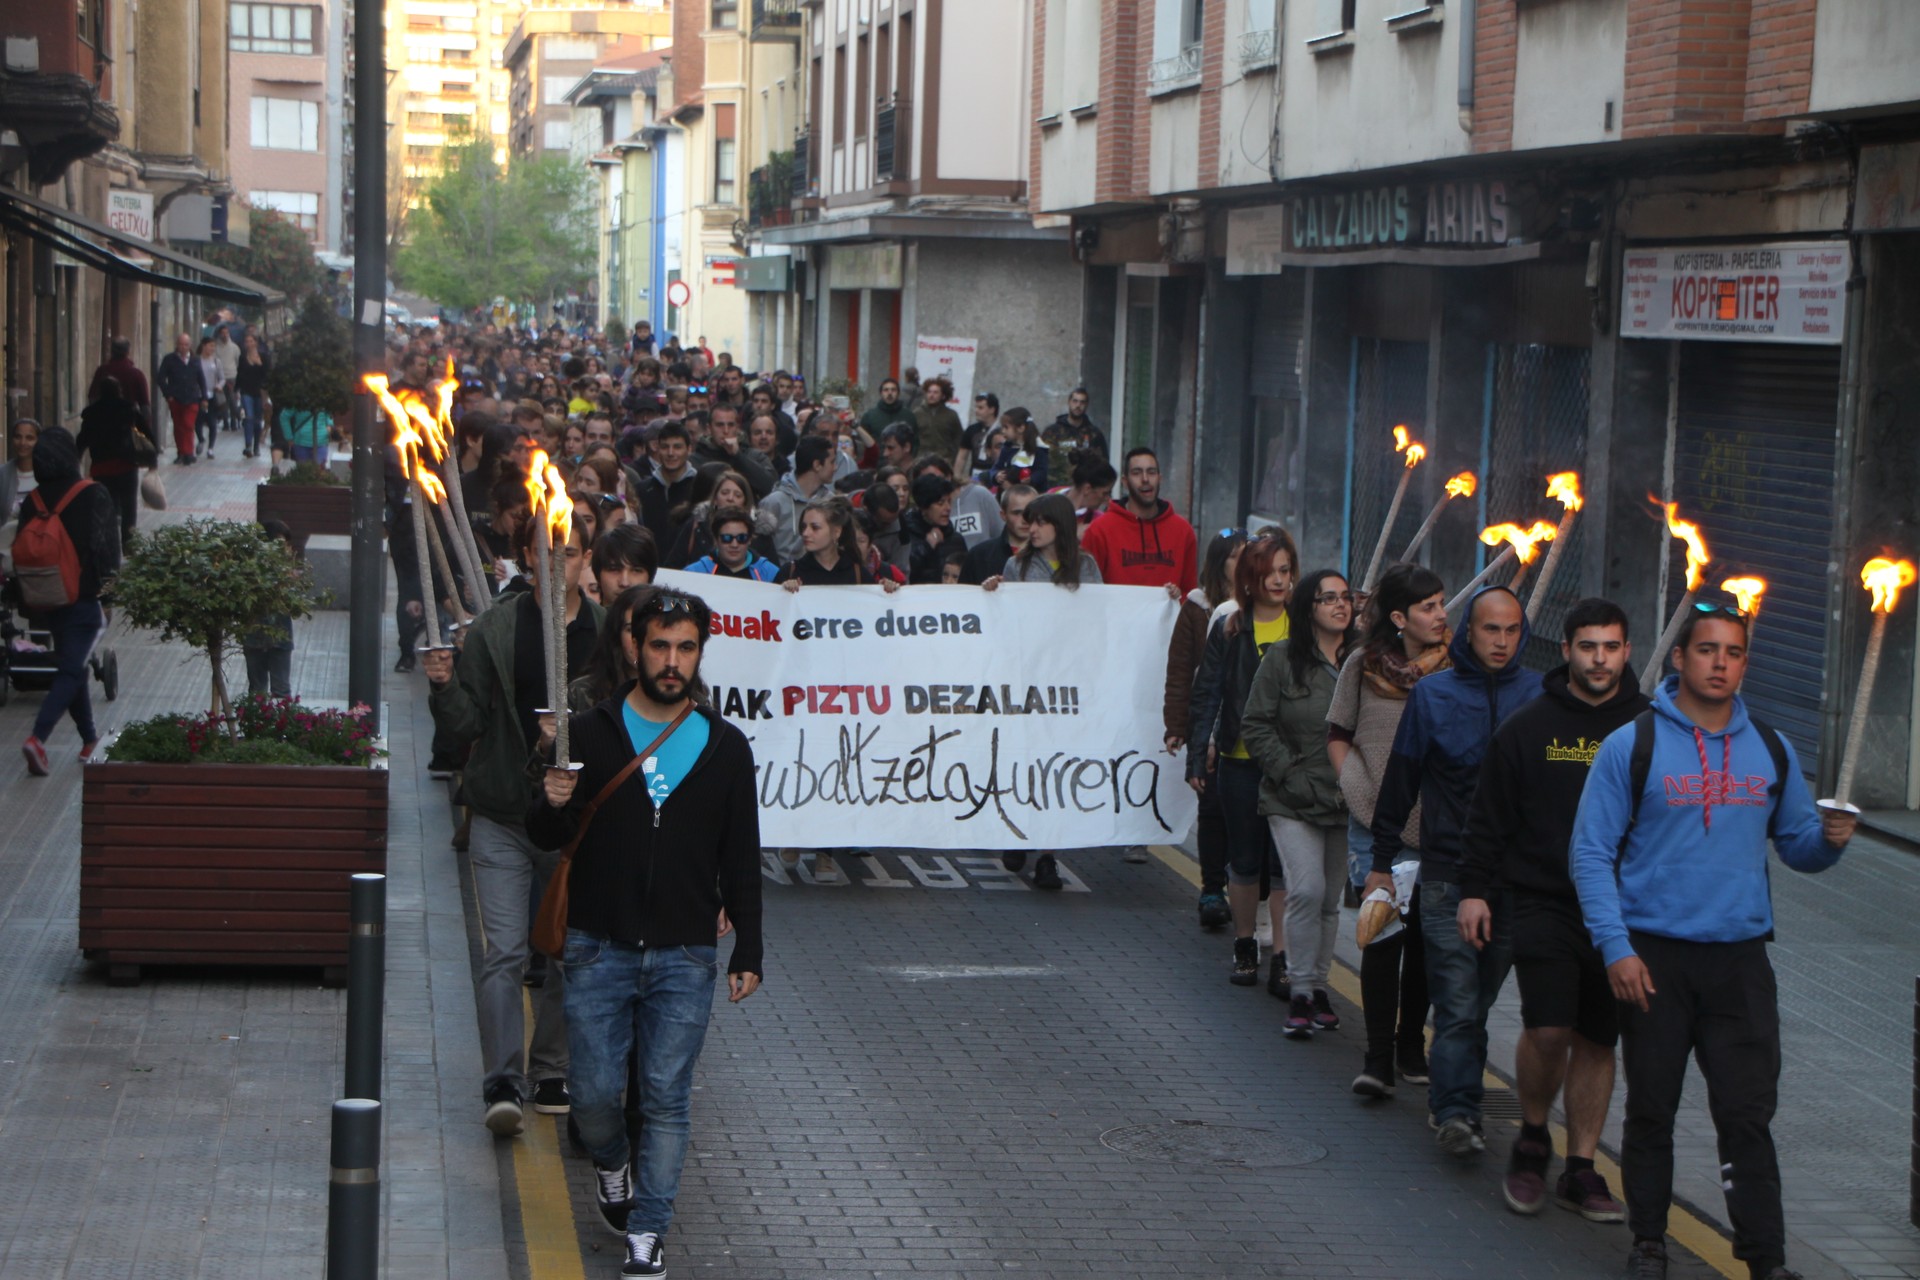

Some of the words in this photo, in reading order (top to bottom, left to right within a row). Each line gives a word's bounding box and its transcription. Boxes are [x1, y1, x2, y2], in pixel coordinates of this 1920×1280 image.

[113, 195, 142, 210] FRUTERIA
[1291, 185, 1409, 248] CALZADOS
[1425, 181, 1510, 245] ARIAS
[1673, 252, 1724, 271] KOPISTERIA
[1731, 251, 1782, 270] PAPELERIA
[792, 616, 863, 641] erre
[875, 609, 982, 639] duena
[782, 685, 891, 717] PIZTU
[904, 684, 1080, 716] DEZALA!!!
